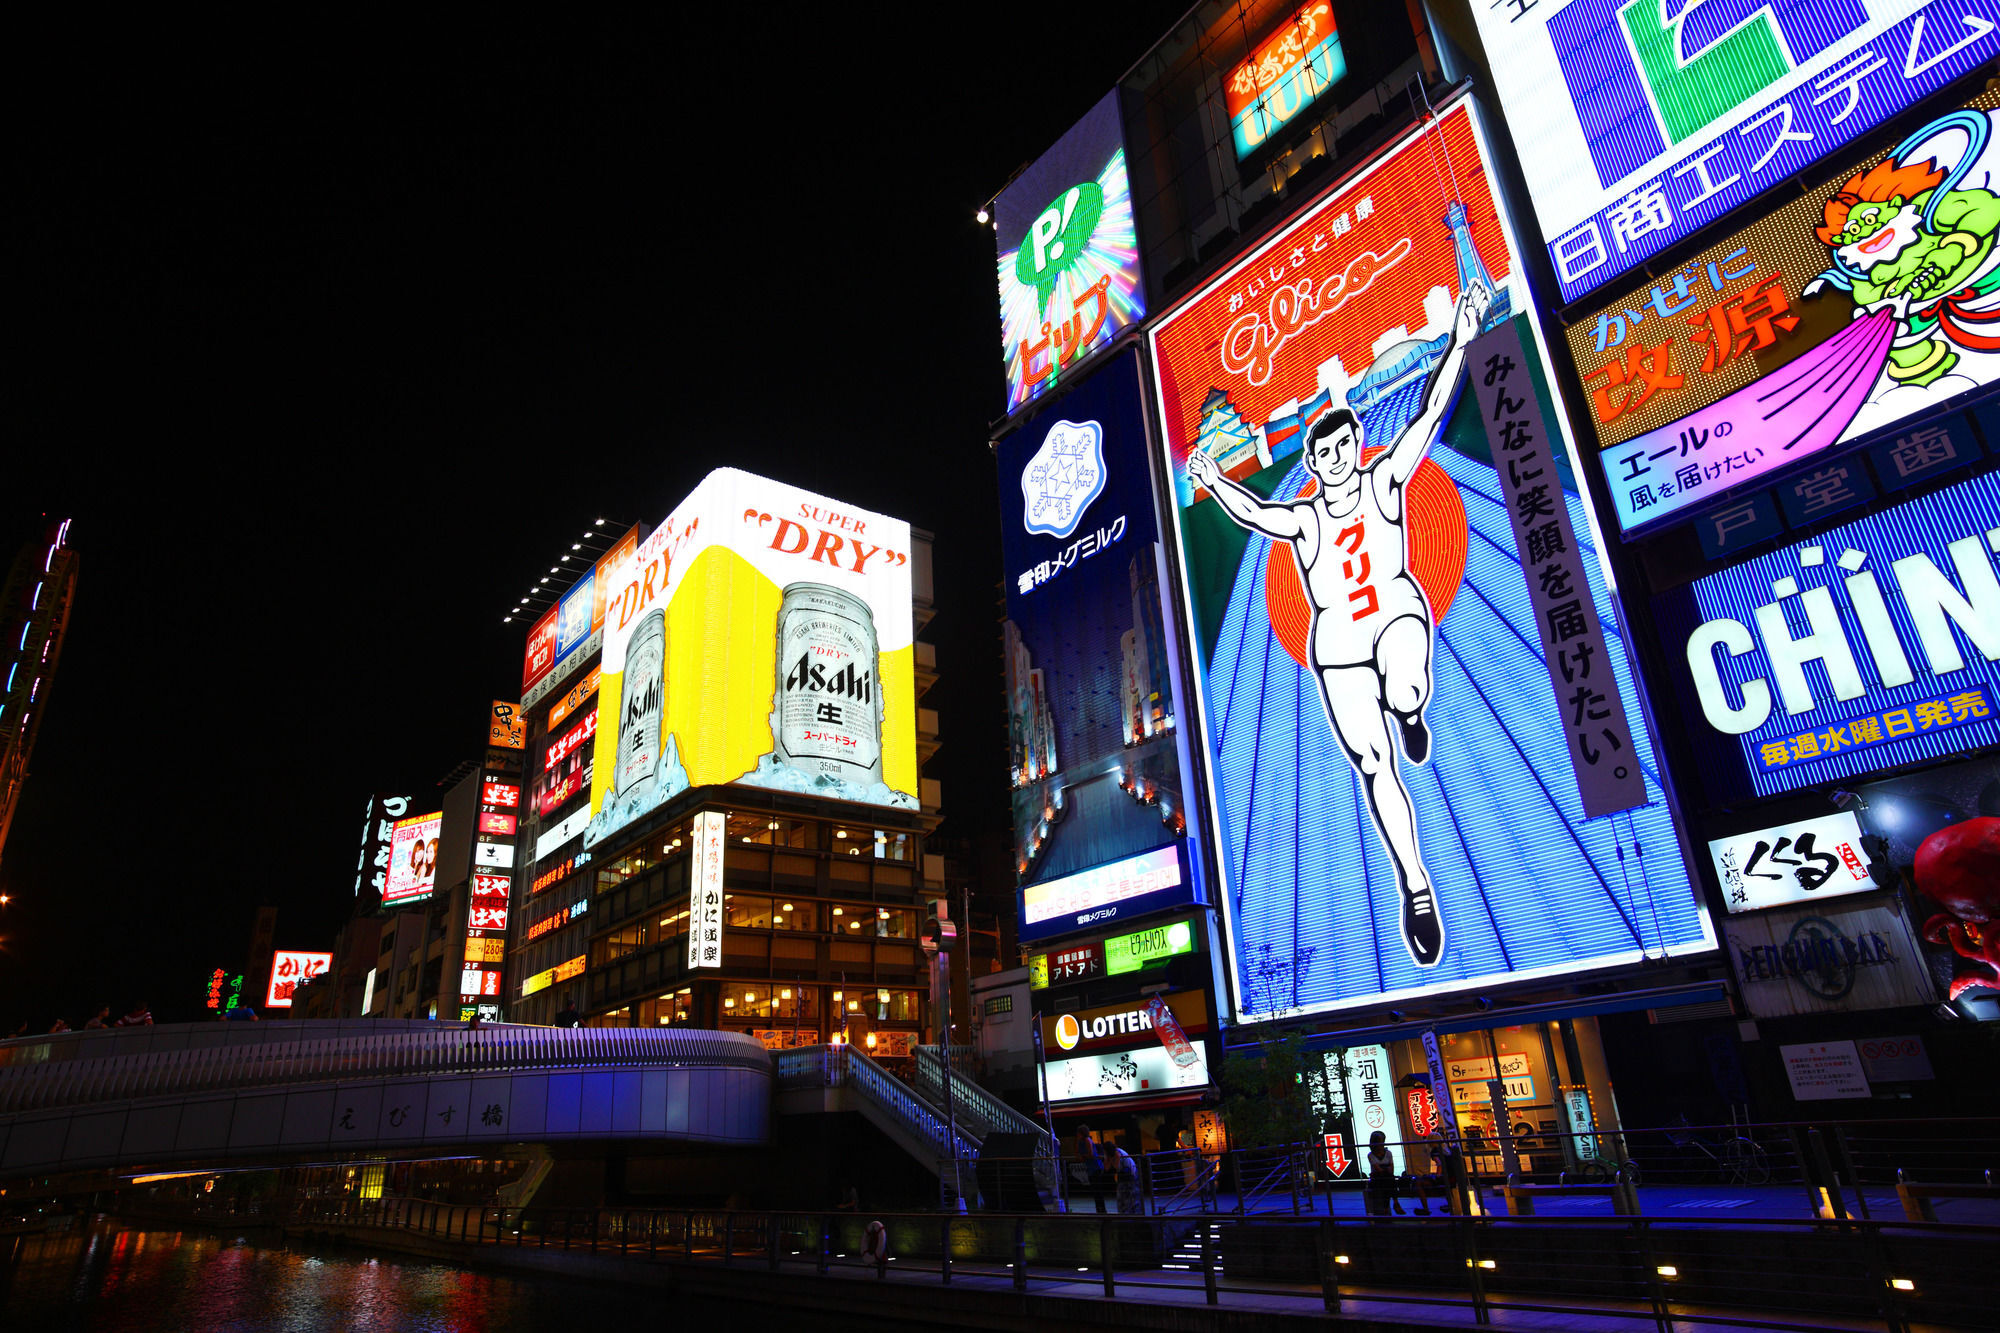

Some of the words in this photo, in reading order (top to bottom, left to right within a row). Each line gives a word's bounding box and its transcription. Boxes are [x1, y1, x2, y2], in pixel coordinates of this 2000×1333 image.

[1242, 43, 1334, 146] UUU
[1554, 15, 1996, 286] 日商エステム
[1031, 187, 1080, 273] P!
[1228, 194, 1376, 314] おいしさと健康
[1588, 246, 1757, 353] かぜに
[1021, 274, 1112, 388] ピップ
[1584, 271, 1801, 424] 改源
[1619, 420, 1733, 482] エールの
[1629, 447, 1765, 514] 風を届けたい
[635, 517, 674, 570] SUPER
[798, 503, 867, 535] SUPER
[1017, 515, 1128, 595] 雪印メグミルク
[1334, 513, 1380, 622] グリコ
[1483, 352, 1630, 782] みんなに笑顔を届けたい。
[786, 651, 871, 705] Asahi
[621, 677, 660, 739] Asahi
[816, 702, 843, 725] 生
[1760, 689, 1991, 770] 毎週水曜日発売
[631, 728, 645, 754] 生
[803, 731, 857, 748] スーパードライ
[819, 761, 842, 773] 350ml
[482, 805, 496, 813] 7F
[474, 876, 510, 896] はや
[1744, 832, 1840, 891] くくる
[471, 907, 506, 928] はや
[704, 891, 719, 961] かに道楽
[1076, 906, 1118, 926] 雪印メグミルク
[278, 957, 325, 979] かに
[464, 962, 479, 970] 2F
[1053, 958, 1099, 981] アドアド
[1082, 1007, 1170, 1040] LOTTER
[1357, 1059, 1382, 1103] 河童
[1451, 1064, 1467, 1079] 8F
[1455, 1087, 1469, 1101] 7F
[338, 1103, 504, 1131] えびす橋
